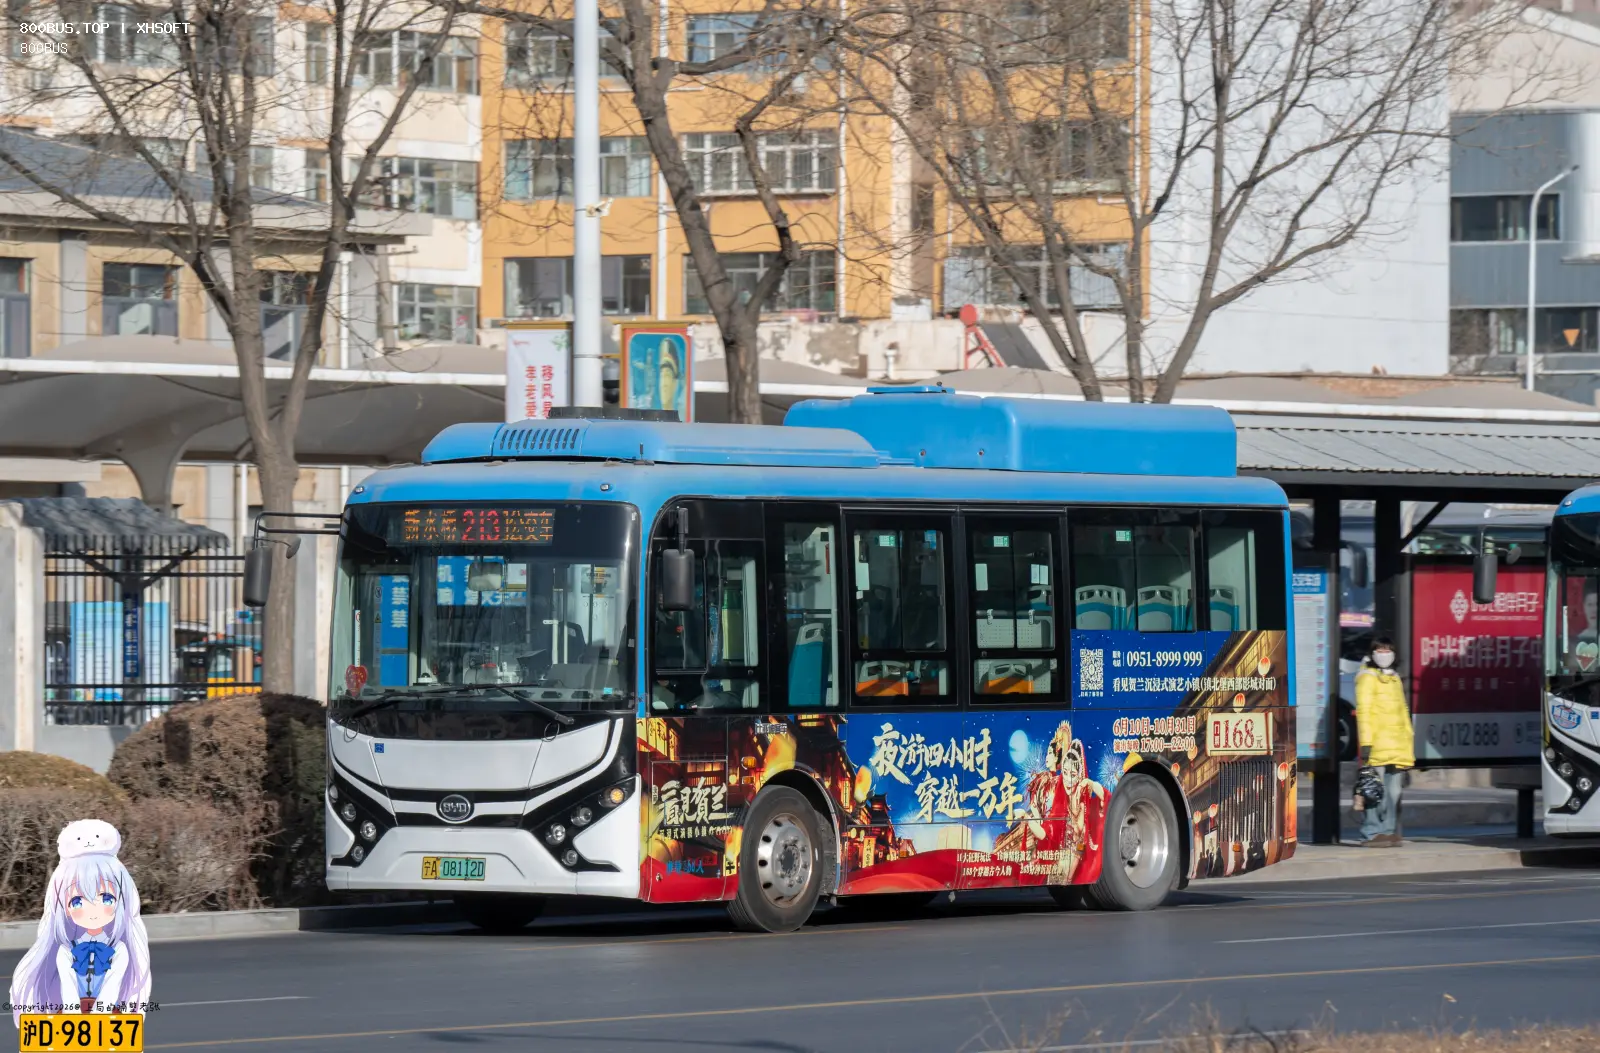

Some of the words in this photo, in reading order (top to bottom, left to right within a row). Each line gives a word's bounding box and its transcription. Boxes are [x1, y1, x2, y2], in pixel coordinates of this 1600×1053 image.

[462, 509, 501, 541] 213
[1126, 650, 1181, 668] 0951-8999
[1183, 650, 1203, 666] 999
[914, 771, 1023, 828] 穿越一万年
